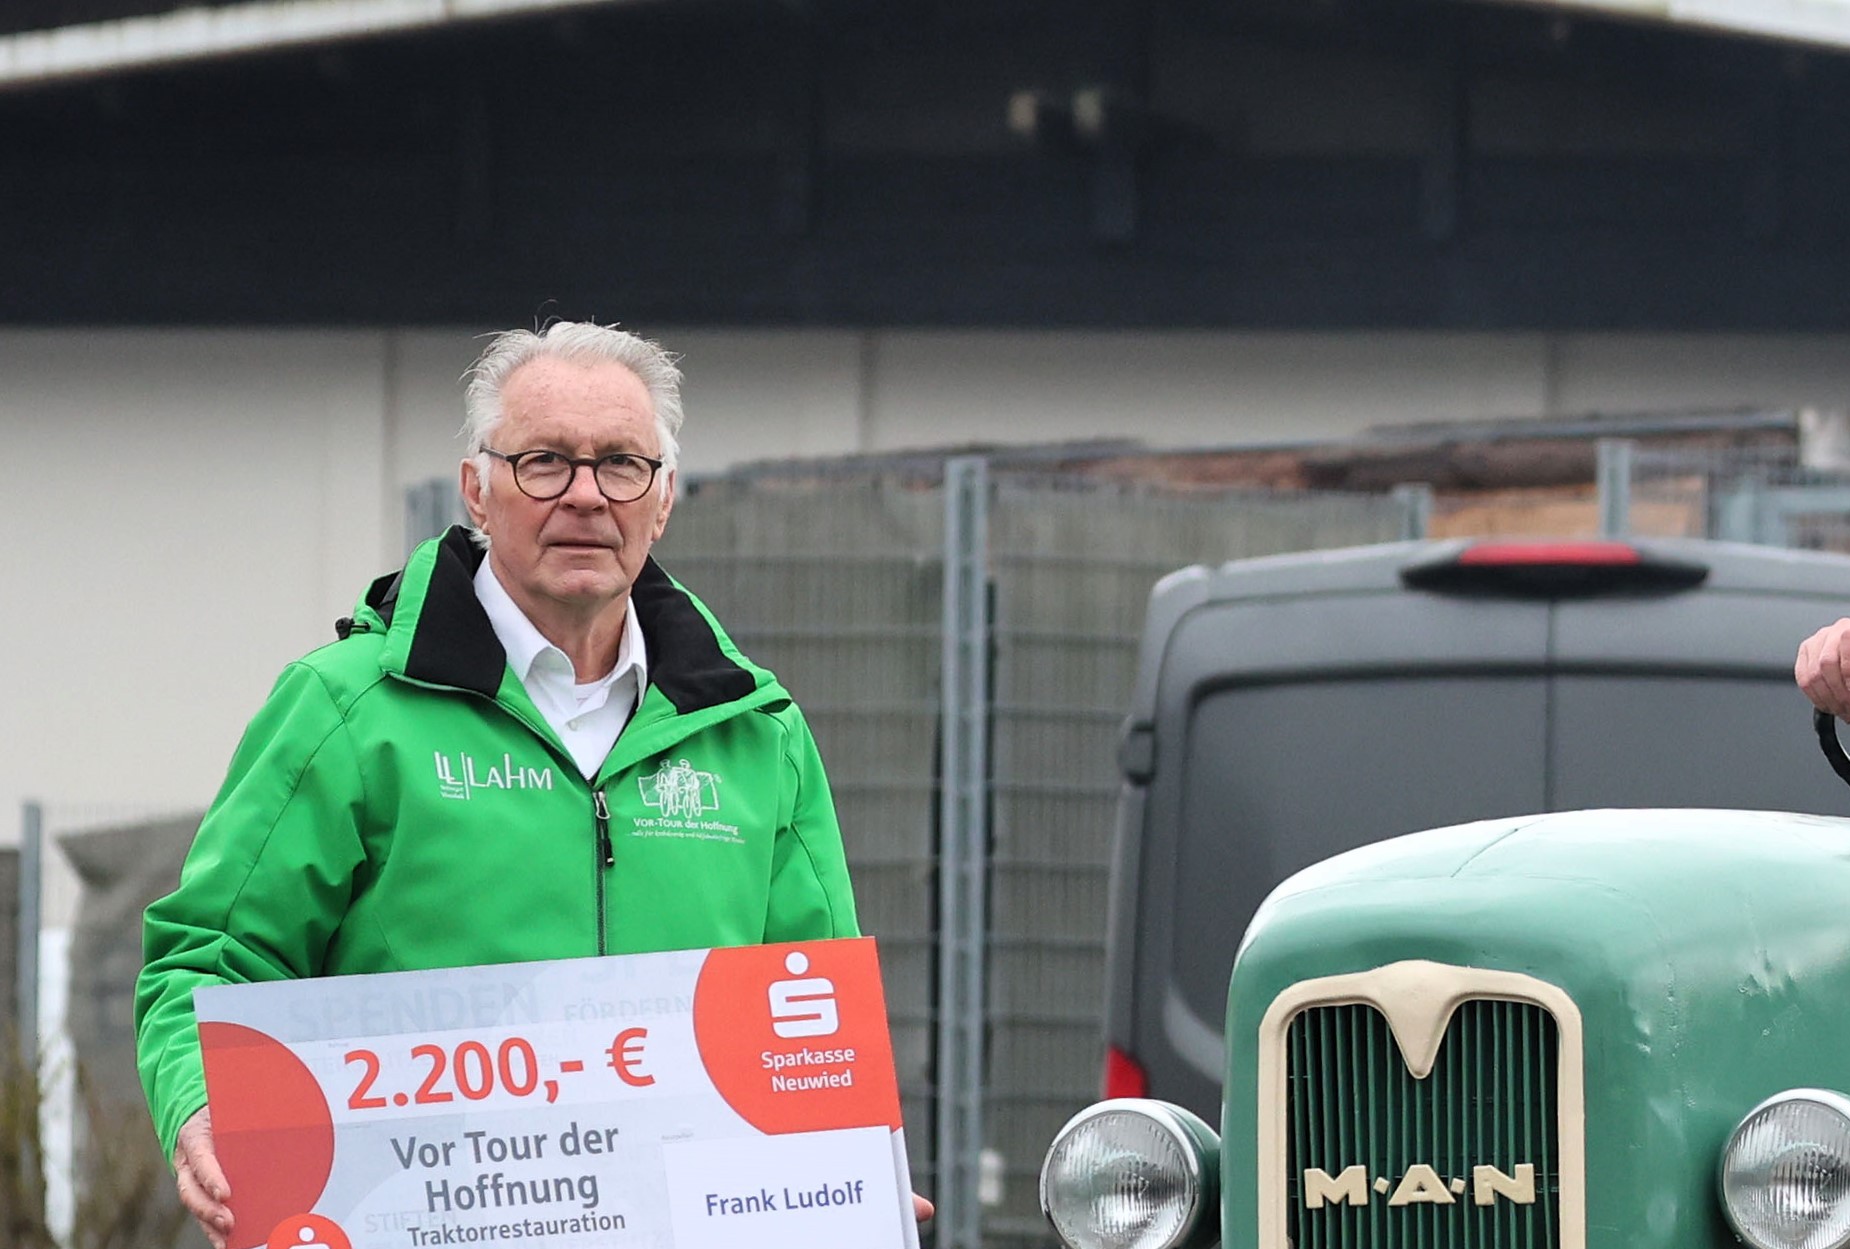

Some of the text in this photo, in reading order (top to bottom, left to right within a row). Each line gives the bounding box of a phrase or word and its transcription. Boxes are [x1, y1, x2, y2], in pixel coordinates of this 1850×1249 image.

[605, 1027, 656, 1088] €
[760, 1046, 857, 1071] Sparkasse
[770, 1067, 854, 1093] Neuwied
[389, 1122, 620, 1171] Vor Tour der
[423, 1171, 600, 1217] Hoffnung
[705, 1178, 864, 1218] Frank Ludolf
[406, 1208, 627, 1248] Traktorrestauration
